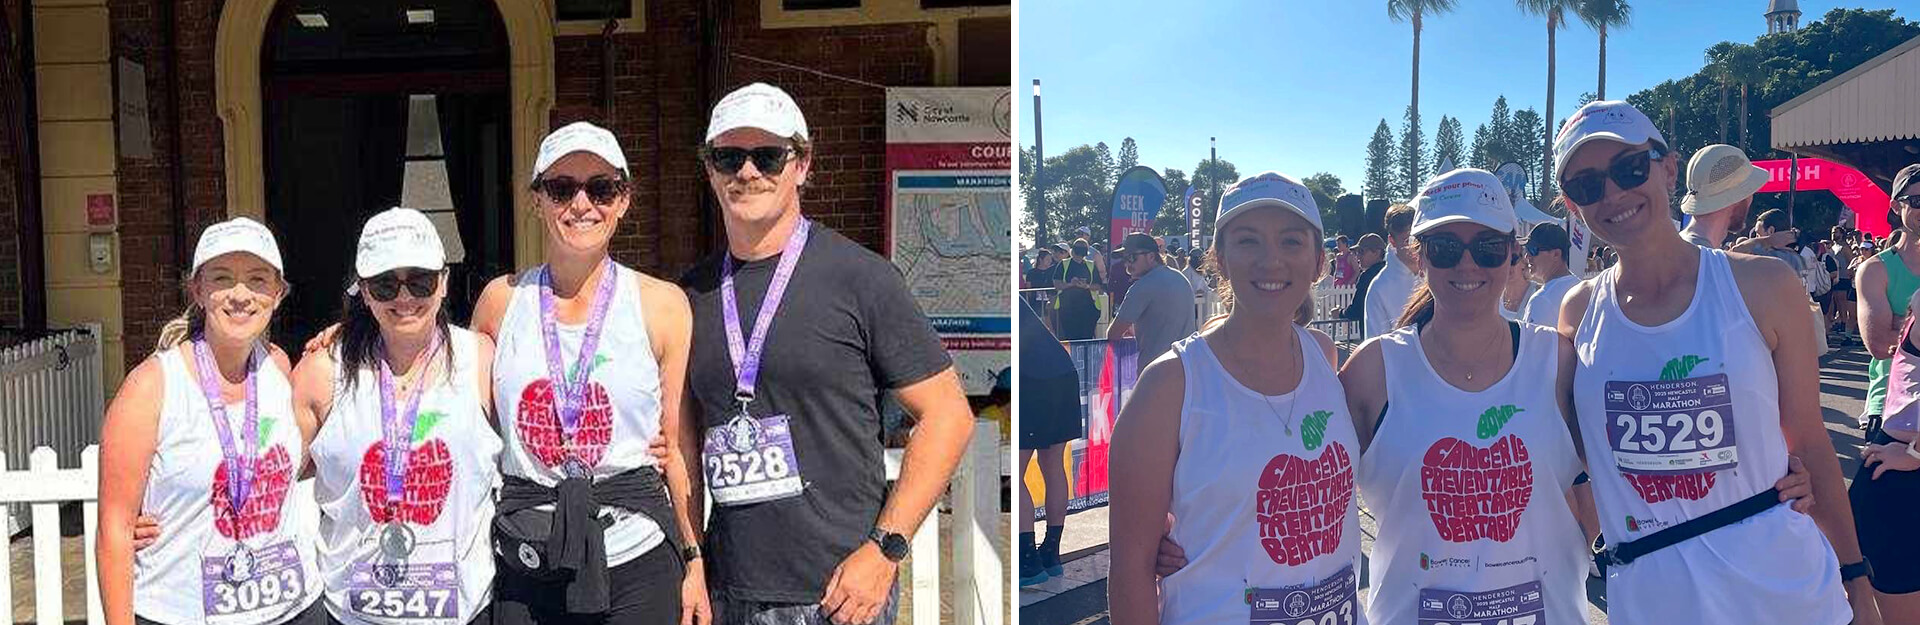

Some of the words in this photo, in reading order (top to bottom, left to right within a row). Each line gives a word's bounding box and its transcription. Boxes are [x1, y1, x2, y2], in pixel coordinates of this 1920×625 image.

[923, 115, 970, 123] Newcastle
[1443, 184, 1461, 192] your
[1767, 165, 1820, 182] ISH
[1120, 195, 1144, 211] SEEK
[1131, 211, 1149, 227] OFF
[1191, 197, 1201, 250] COFFE
[1651, 382, 1697, 395] HENDERSON
[1667, 388, 1697, 397] NEWCASTLE
[1652, 399, 1701, 410] MARATHON
[1477, 404, 1525, 440] BOWEL
[1616, 410, 1724, 453] 2529
[708, 445, 789, 488] 2528
[1258, 444, 1337, 489] CANCER
[1333, 441, 1351, 470] IS
[1423, 436, 1511, 470] CANCER
[1510, 434, 1529, 464] IS
[1256, 466, 1353, 515] PREVENTABLE
[1420, 462, 1533, 496] PREVENTABLE
[1622, 472, 1718, 504] BEATABLE
[1256, 490, 1352, 538] TREATABLE
[1422, 487, 1532, 518] TREATABLE
[1261, 514, 1346, 567] BEATABLE
[1430, 509, 1526, 543] BEATABLE
[1449, 557, 1471, 565] Cancer
[214, 568, 301, 614] 3093
[359, 589, 451, 618] 2547
[1310, 593, 1344, 614] MARATHON
[1472, 590, 1515, 601] HENDERSON
[1489, 597, 1515, 606] NEWCASTLE
[1473, 605, 1519, 618] MARATHON
